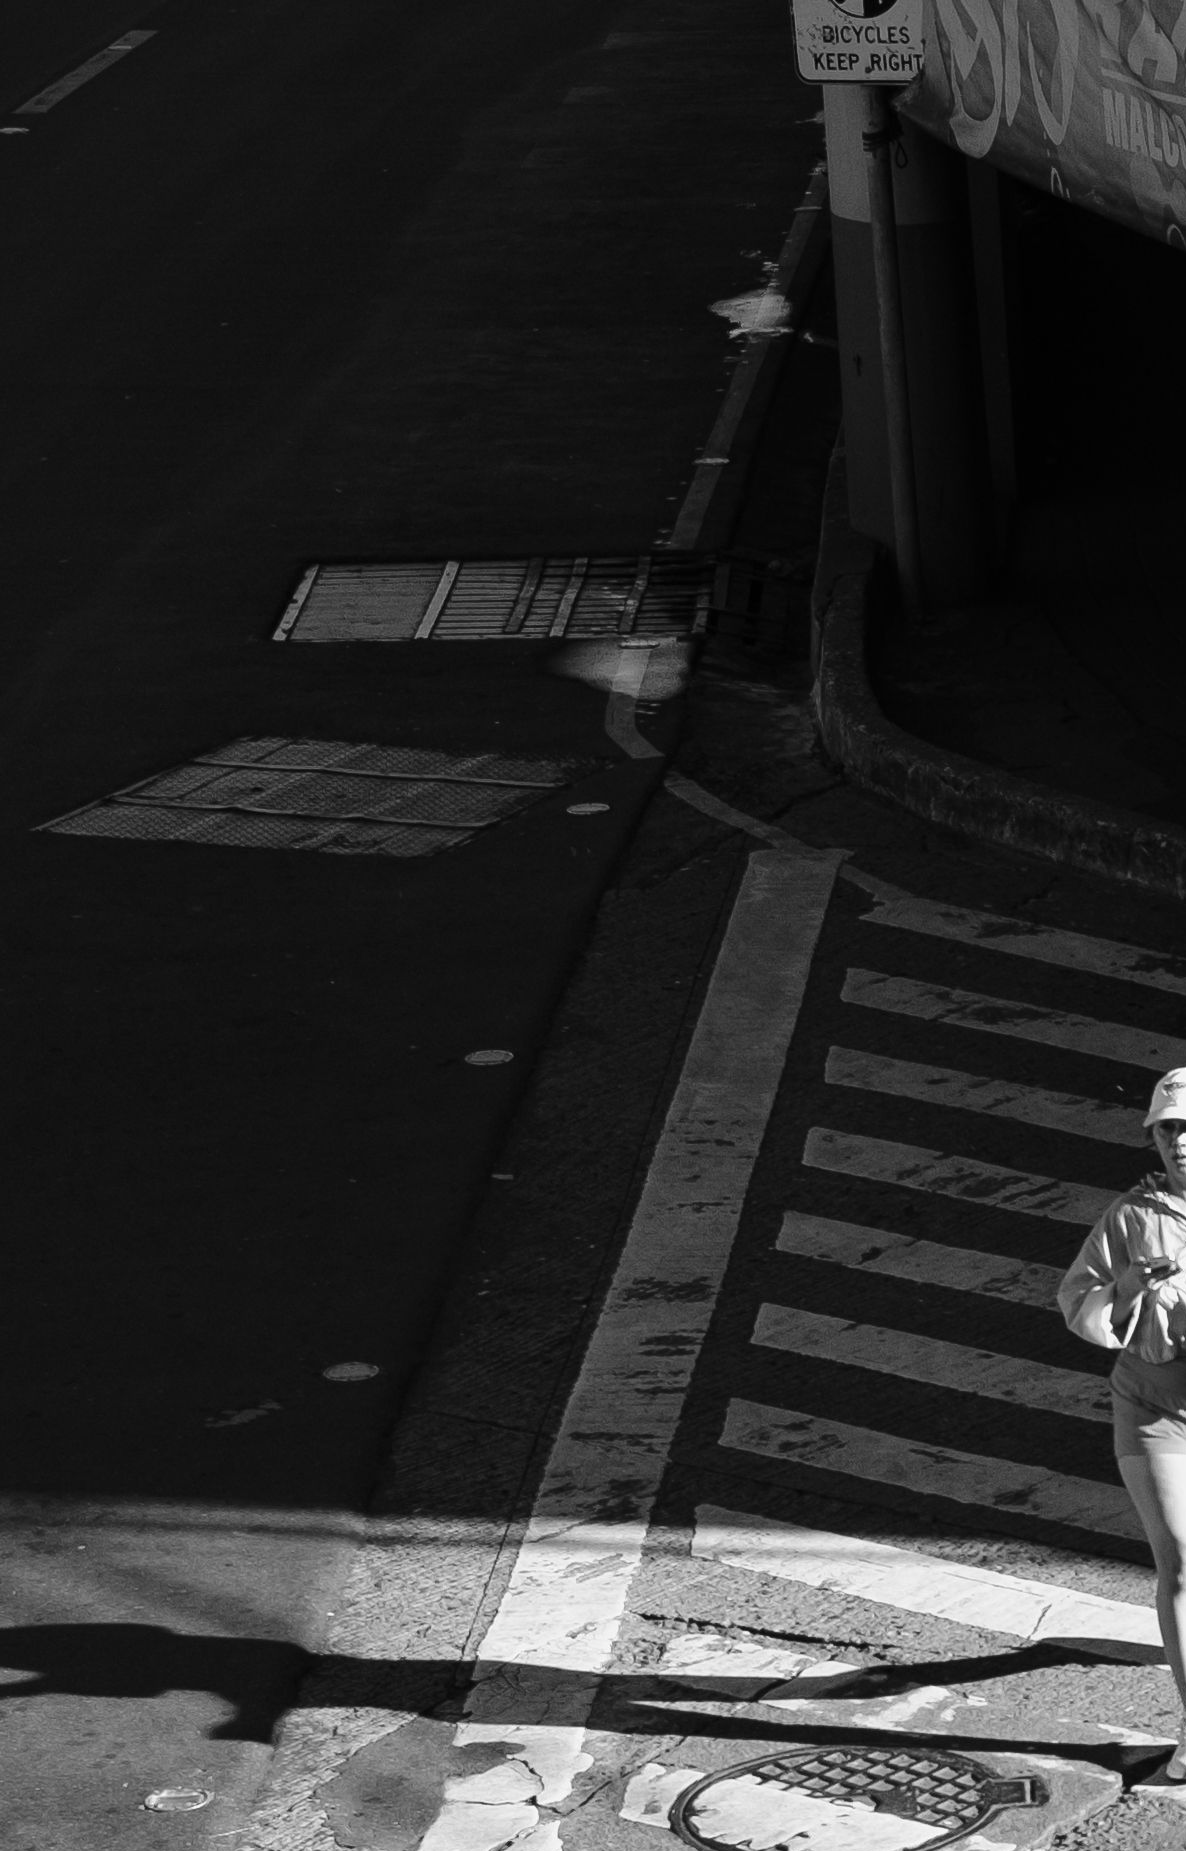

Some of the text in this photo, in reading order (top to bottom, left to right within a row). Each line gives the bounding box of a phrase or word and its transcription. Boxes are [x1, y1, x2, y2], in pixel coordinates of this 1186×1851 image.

[822, 25, 910, 44] BICYCLES
[813, 53, 923, 71] KEEP RIGHT
